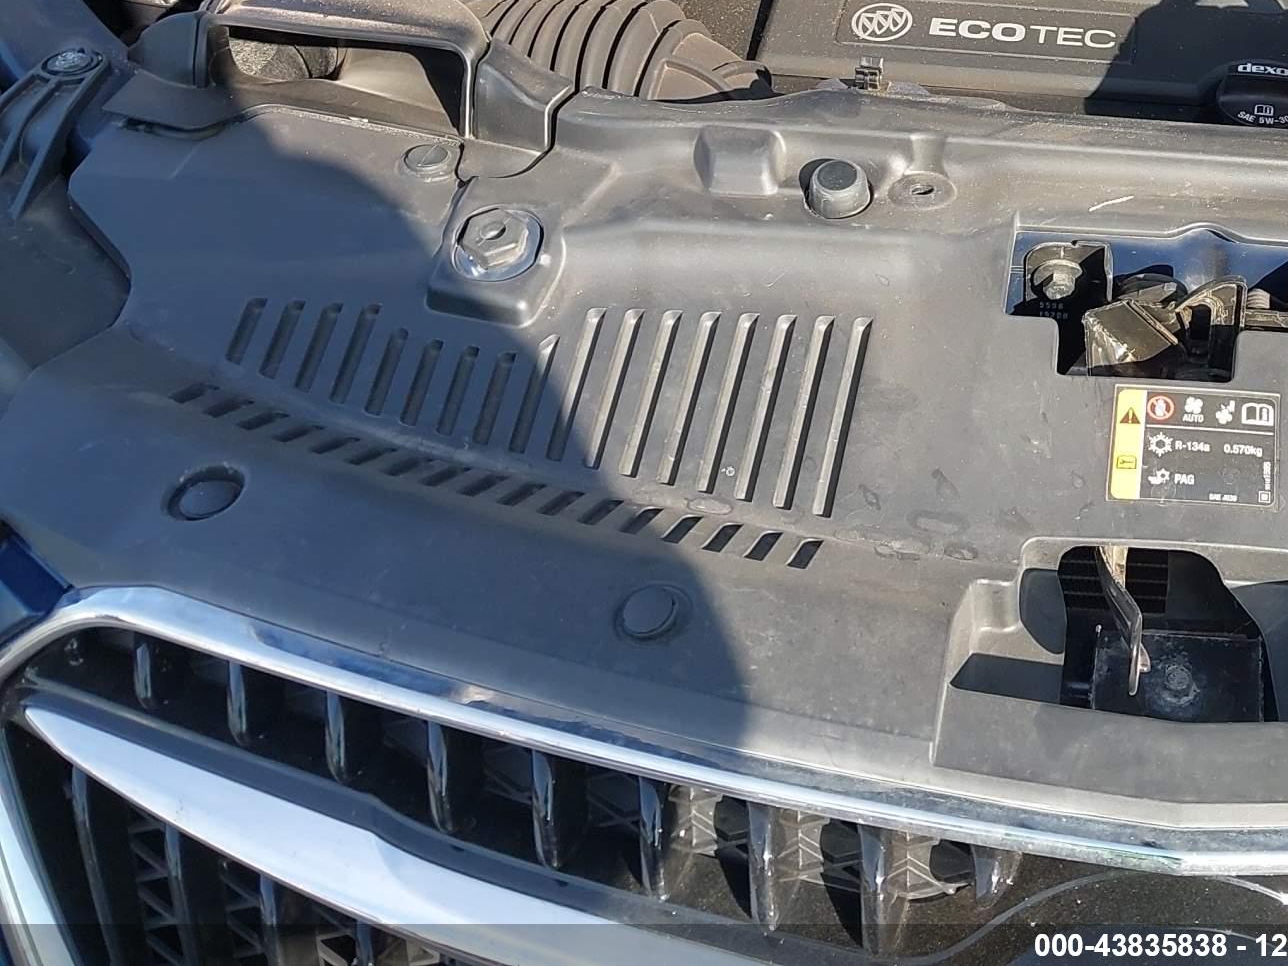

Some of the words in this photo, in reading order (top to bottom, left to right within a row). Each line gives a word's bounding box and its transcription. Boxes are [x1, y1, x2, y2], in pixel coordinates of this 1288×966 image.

[928, 17, 1117, 49] ECOTEC
[1237, 110, 1257, 123] SAE
[1182, 413, 1204, 423] AUTO
[1174, 440, 1211, 453] R-134a
[1223, 443, 1263, 458] 0.570kg
[1173, 472, 1195, 485] PAG
